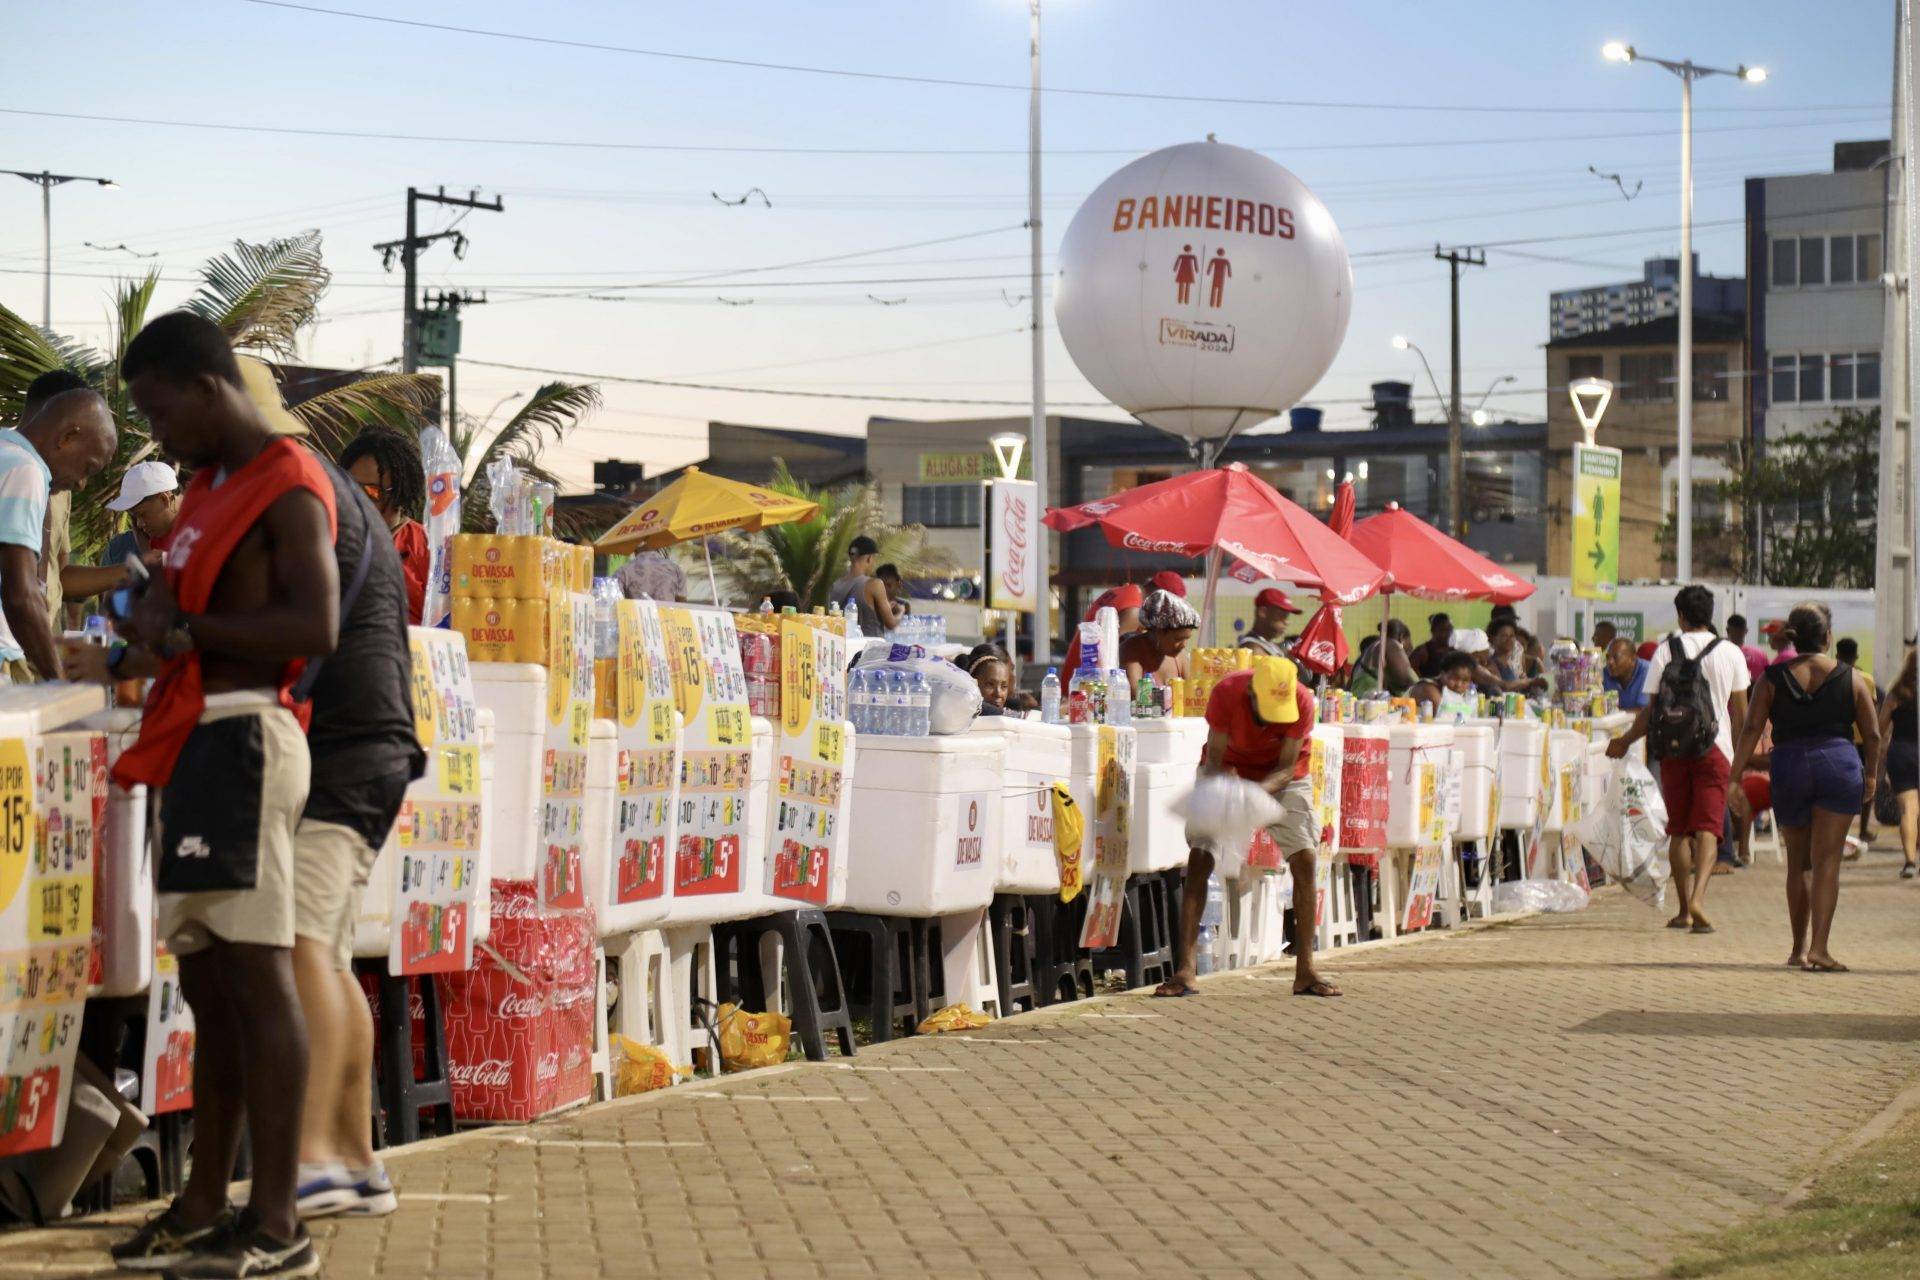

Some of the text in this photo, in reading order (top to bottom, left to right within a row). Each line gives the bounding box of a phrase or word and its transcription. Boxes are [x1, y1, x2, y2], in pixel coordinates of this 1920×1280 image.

[1113, 194, 1296, 240] BANHEIROS
[1167, 327, 1229, 344] VIRADA
[471, 563, 516, 579] DEVASSA
[471, 627, 516, 643] DEVASSA
[6, 766, 24, 790] POR
[3, 795, 25, 853] 15
[957, 837, 983, 865] DEVASSA
